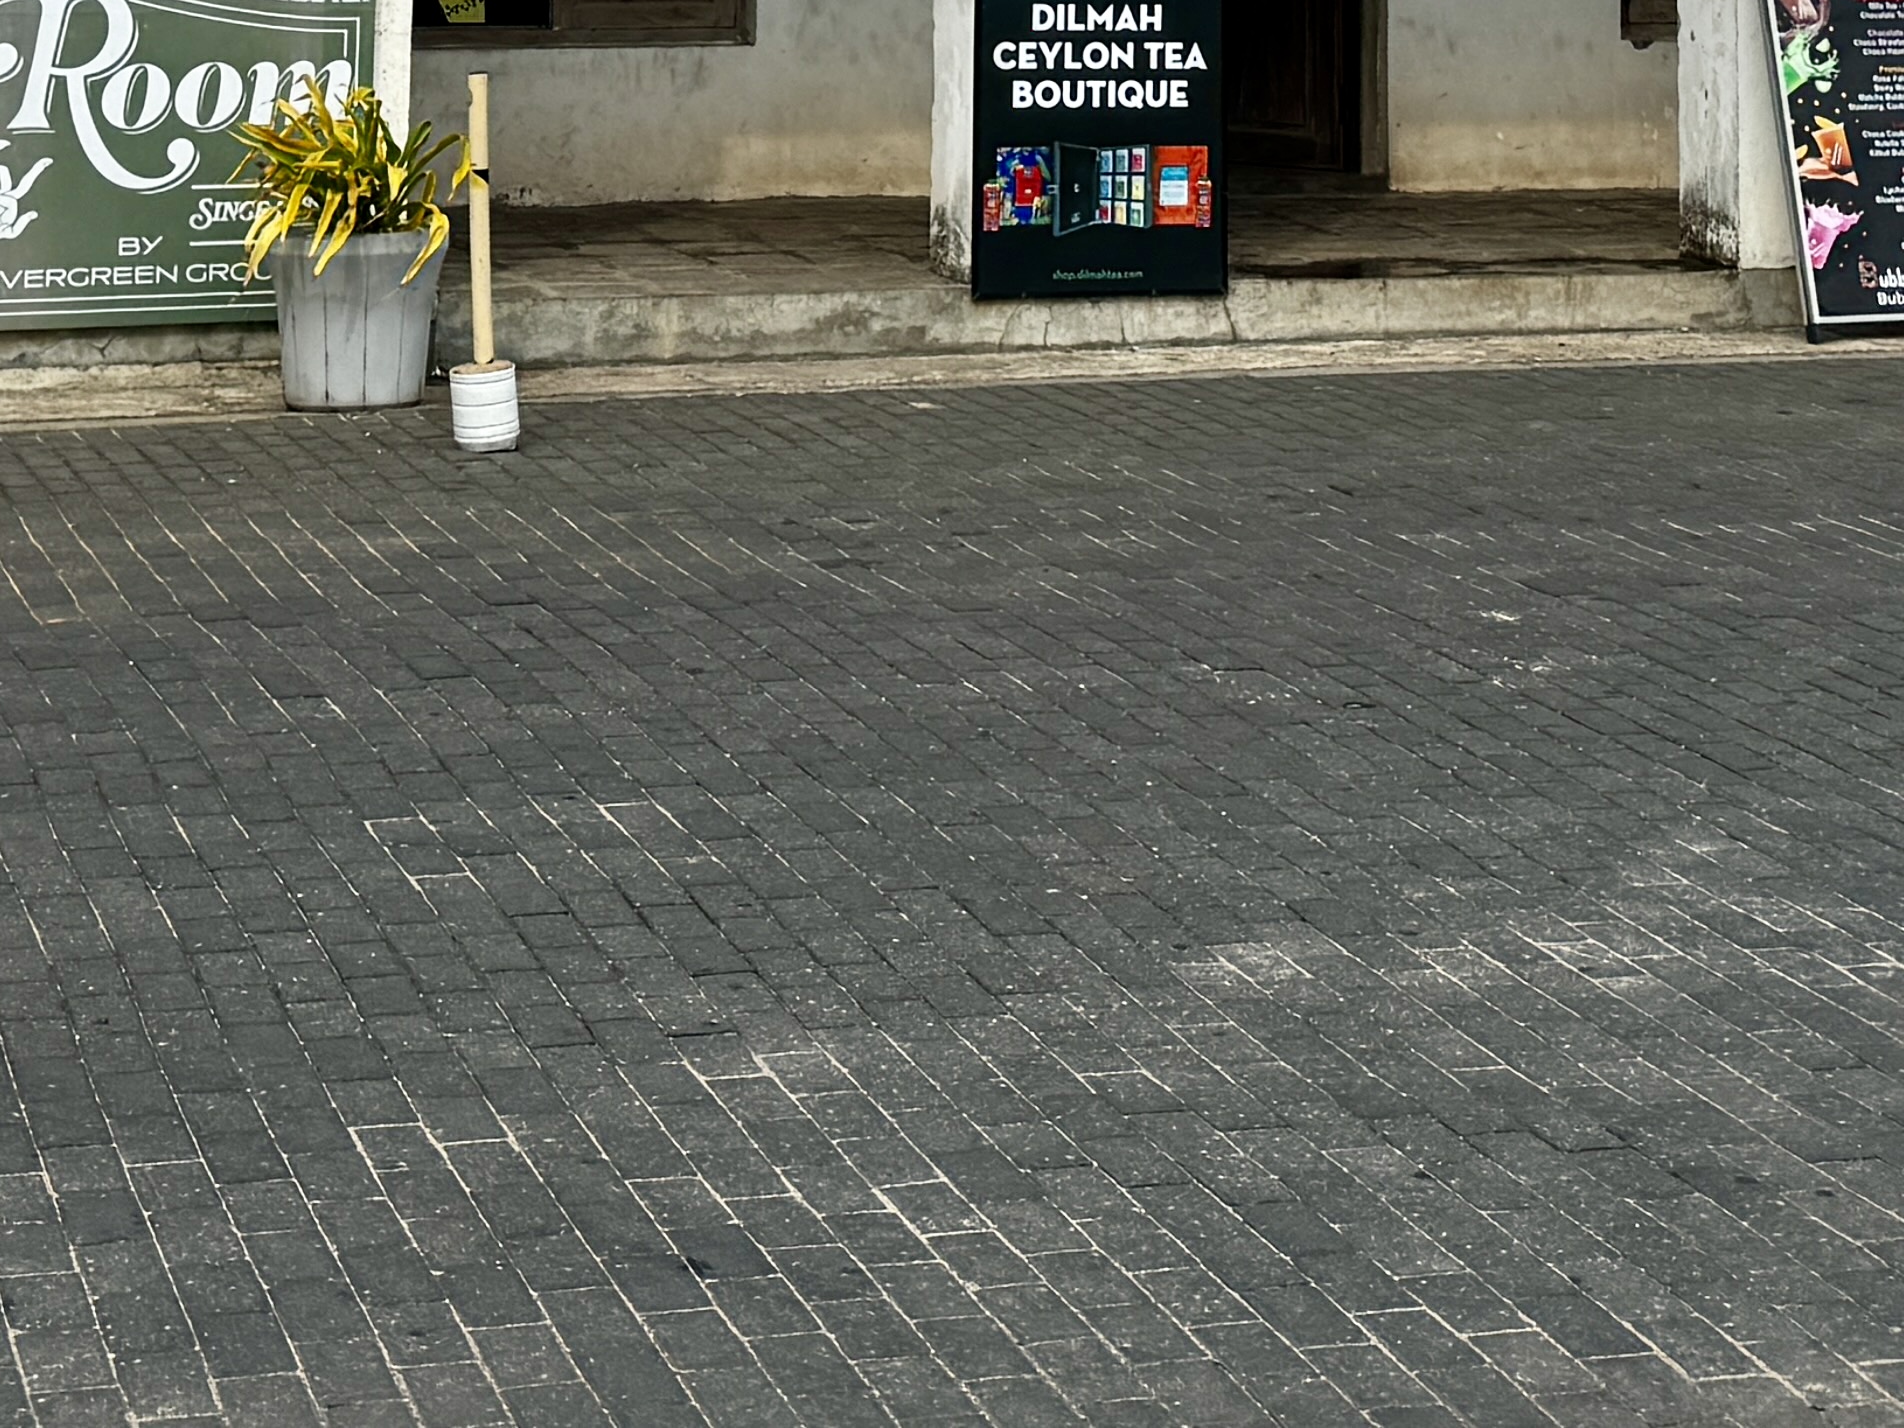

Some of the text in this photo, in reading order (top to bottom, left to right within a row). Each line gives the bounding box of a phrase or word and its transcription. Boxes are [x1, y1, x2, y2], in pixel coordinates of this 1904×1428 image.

[1031, 3, 1163, 32] DILMAH
[992, 40, 1208, 70] CEYLON TEA
[1012, 79, 1189, 109] BOUTIQUE
[118, 236, 163, 257] BY
